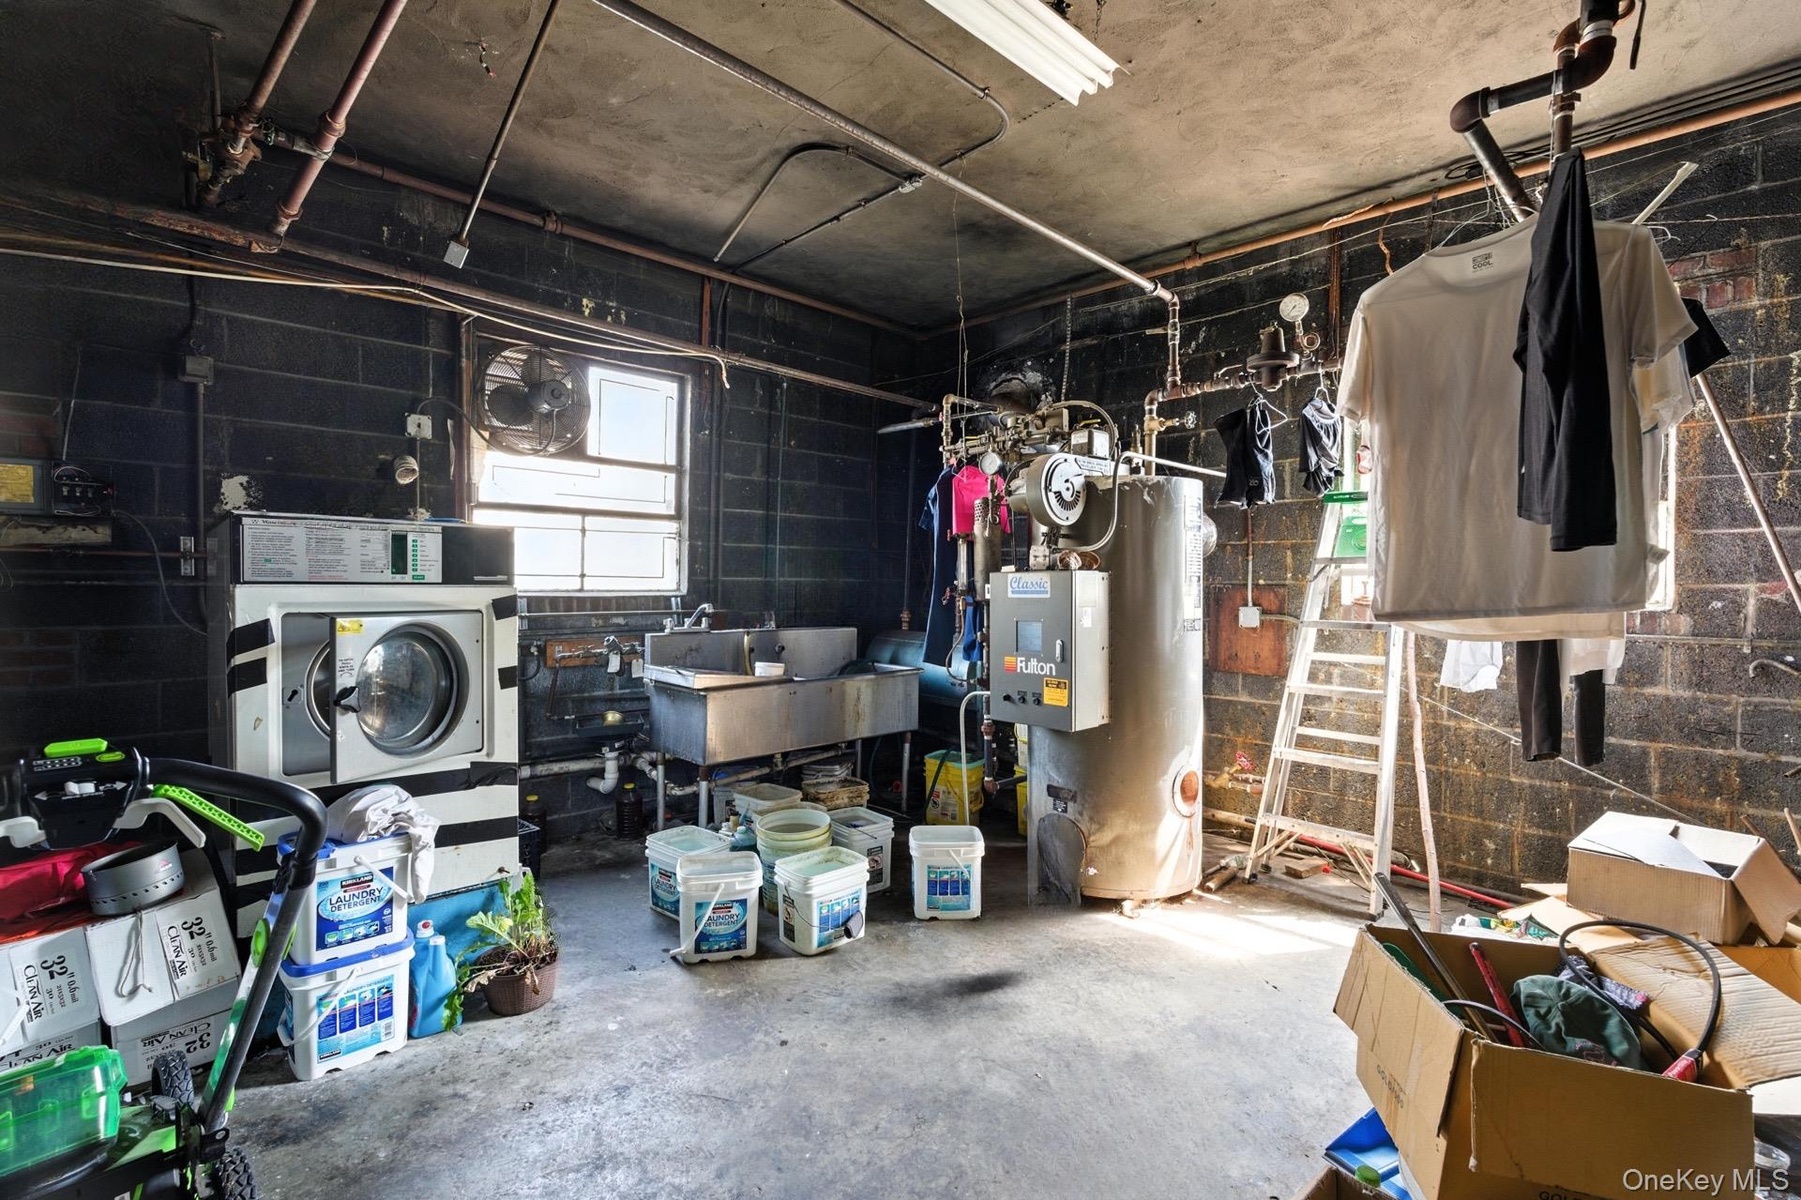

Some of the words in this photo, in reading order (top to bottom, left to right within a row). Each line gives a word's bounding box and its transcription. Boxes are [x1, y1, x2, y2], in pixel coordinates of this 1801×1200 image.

[1472, 260, 1493, 269] COOL
[1010, 576, 1048, 590] Classic
[1017, 657, 1056, 676] Fulton
[342, 875, 373, 885] KIRKLAND
[329, 886, 383, 906] LAUNDRY
[330, 895, 381, 912] DETERGENT
[706, 913, 740, 922] AUNDRY
[188, 947, 195, 958] 30
[46, 988, 54, 999] 30
